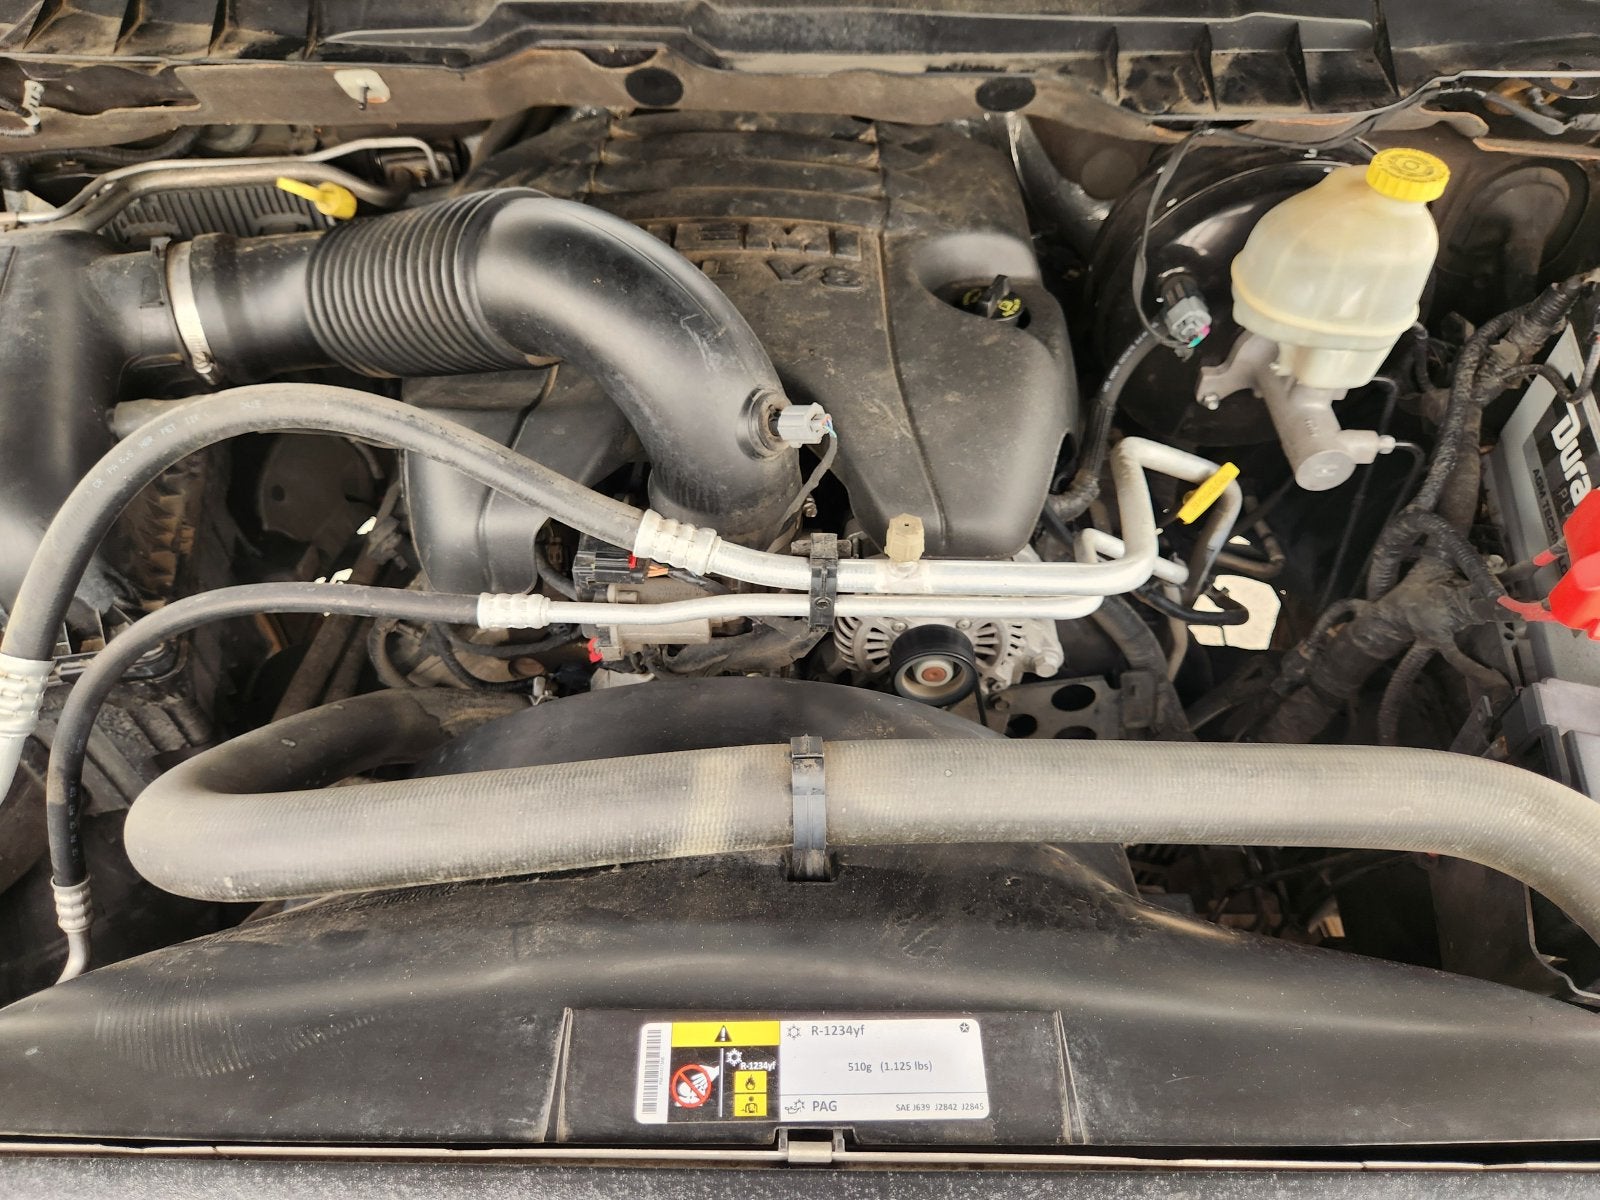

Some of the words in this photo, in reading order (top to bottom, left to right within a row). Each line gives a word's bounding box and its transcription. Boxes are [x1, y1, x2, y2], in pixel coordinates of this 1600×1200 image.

[1551, 402, 1592, 507] Dura
[1532, 468, 1546, 499] AGM
[1556, 485, 1572, 513] PL
[811, 1025, 865, 1038] R-1234yf
[740, 1060, 777, 1072] R-1234yf
[848, 1062, 872, 1073] 510g
[880, 1061, 912, 1073] (1.125
[914, 1061, 933, 1073] lbs)
[812, 1101, 838, 1112] PAG
[896, 1103, 910, 1111] SAE
[912, 1103, 931, 1111] J639
[934, 1103, 957, 1111] J2842
[961, 1102, 984, 1111] J2845
